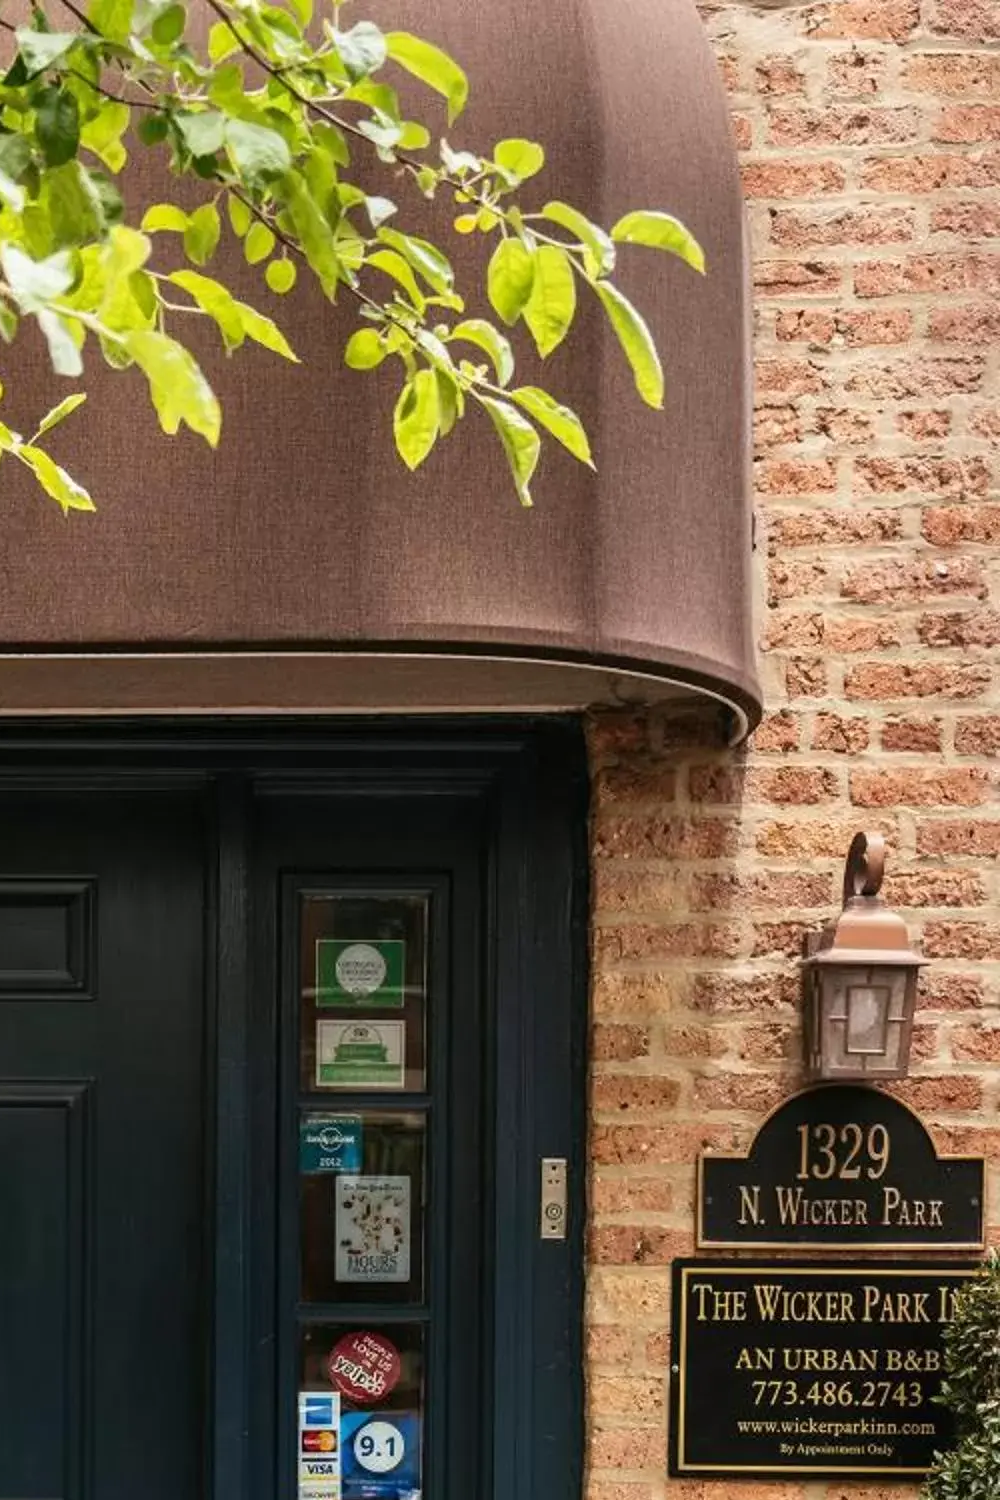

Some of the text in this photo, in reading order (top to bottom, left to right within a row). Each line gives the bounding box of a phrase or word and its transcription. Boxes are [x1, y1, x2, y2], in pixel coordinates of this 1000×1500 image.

[796, 1123, 891, 1180] 1329
[737, 1185, 765, 1226] N.
[691, 1284, 748, 1322] THE
[754, 1285, 854, 1323] WICKER
[863, 1286, 932, 1323] PARK
[353, 1340, 392, 1372] LOVE US
[735, 1348, 941, 1371] AN URBAN B&B
[334, 1356, 370, 1386] yelp
[752, 1380, 923, 1407] 773.486.2743
[736, 1417, 936, 1437] www.wickerparkinn.com
[360, 1436, 395, 1457] 9.1
[779, 1443, 894, 1456] By Appointment Only
[307, 1464, 334, 1475] VISA
